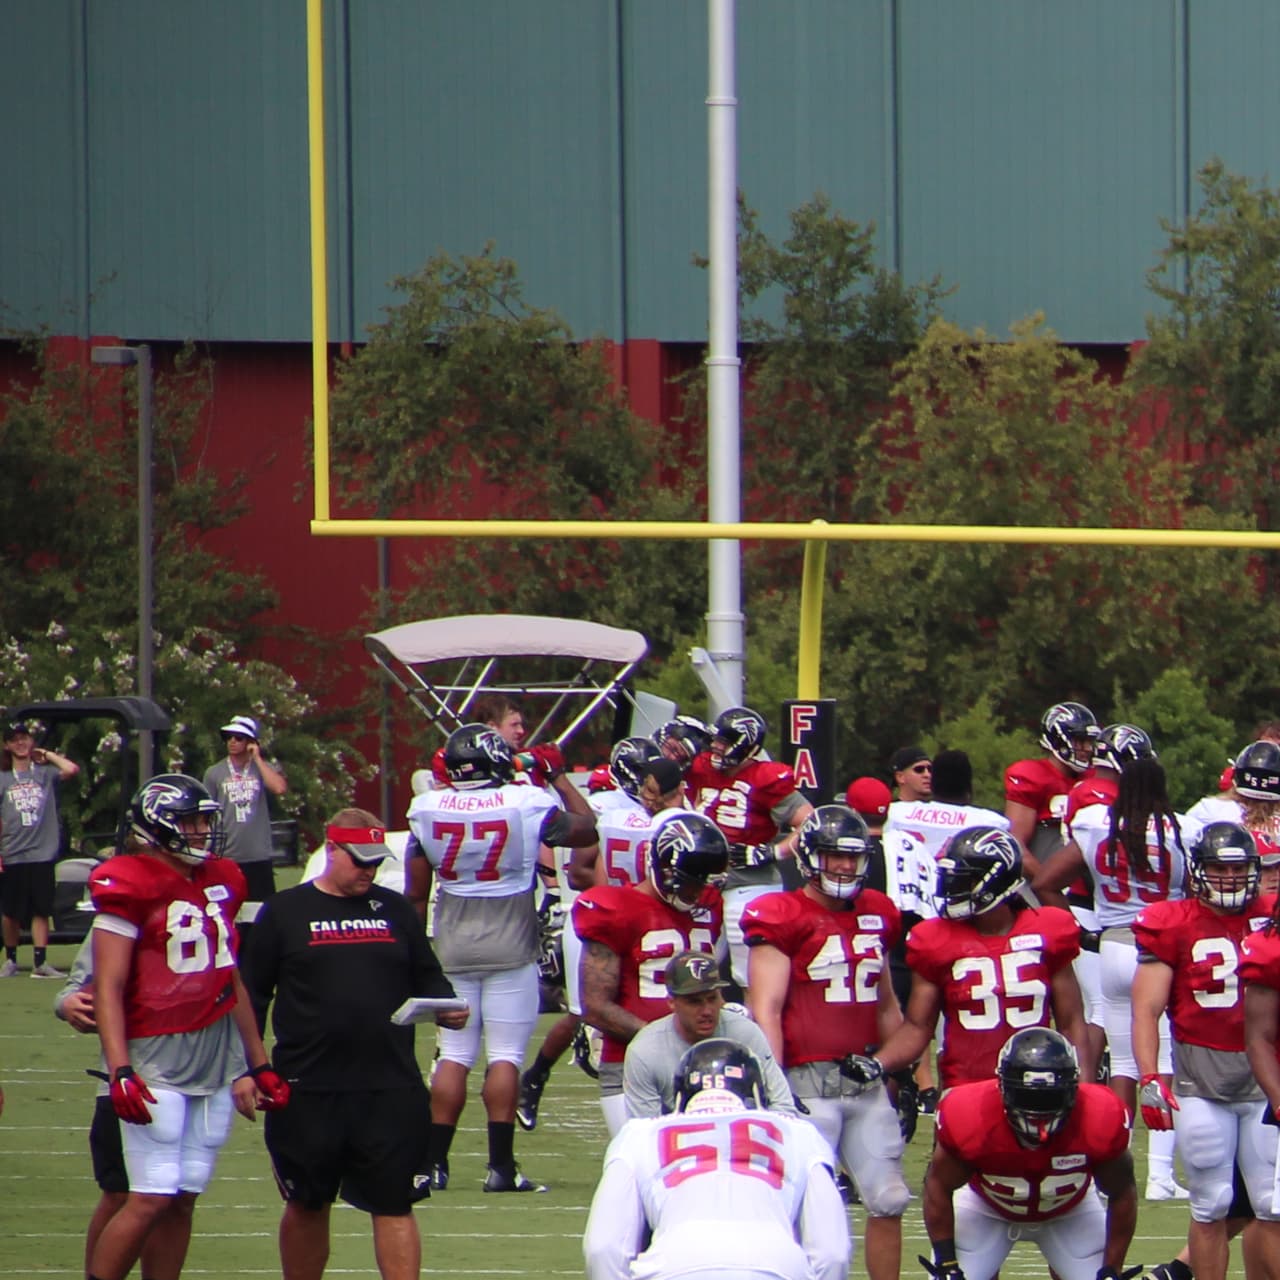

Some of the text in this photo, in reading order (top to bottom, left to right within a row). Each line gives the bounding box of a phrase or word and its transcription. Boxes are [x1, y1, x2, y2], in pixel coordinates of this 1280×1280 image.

[1250, 777, 1268, 788] 52
[905, 807, 967, 826] JACKSON
[432, 819, 509, 881] 77
[166, 900, 236, 974] 81
[309, 919, 390, 940] FALCONS
[807, 934, 884, 1003] 42
[952, 950, 1046, 1029] 35
[702, 1074, 725, 1089] 56
[658, 1118, 784, 1190] 56
